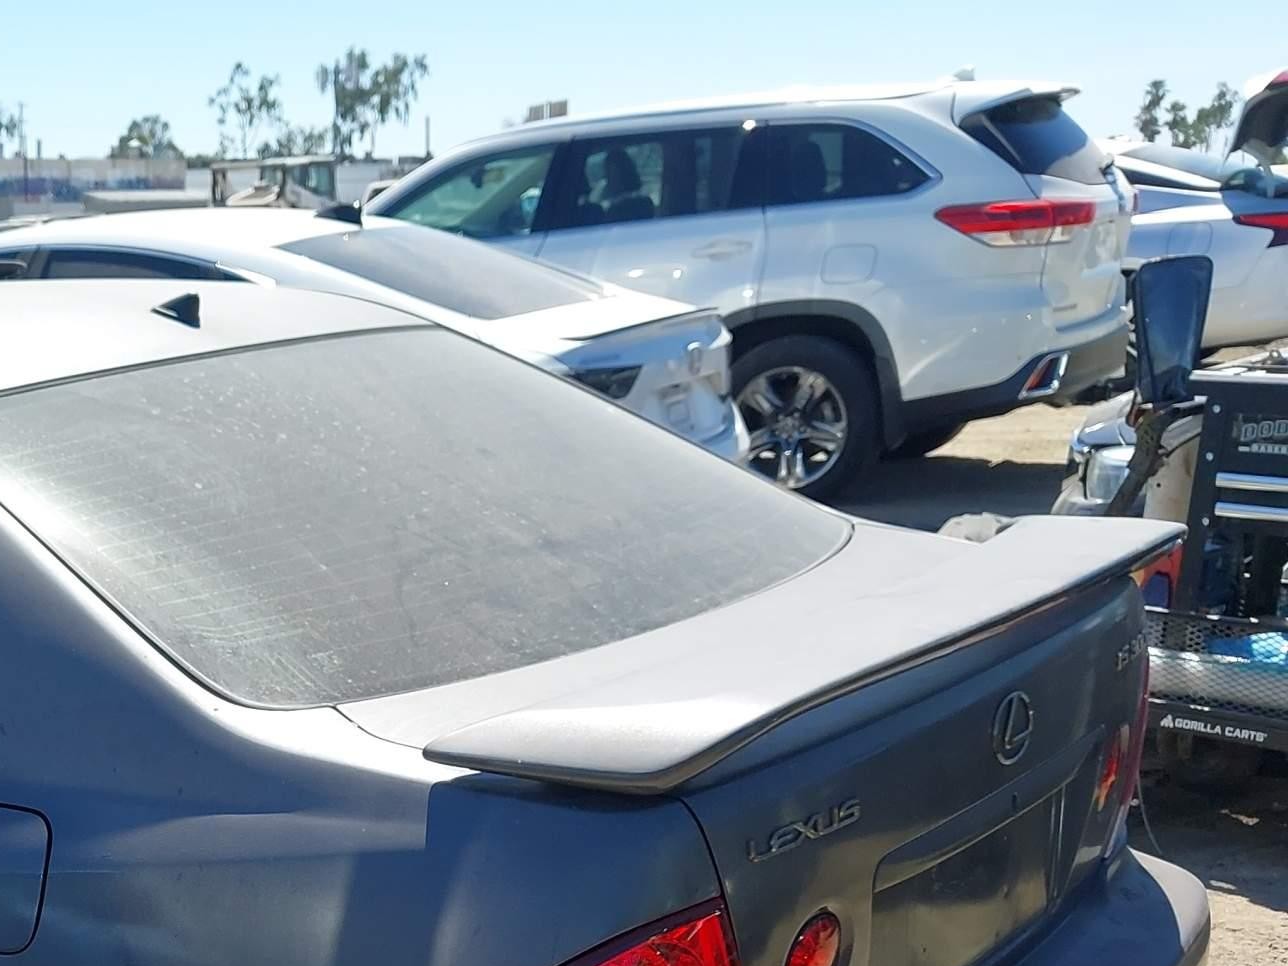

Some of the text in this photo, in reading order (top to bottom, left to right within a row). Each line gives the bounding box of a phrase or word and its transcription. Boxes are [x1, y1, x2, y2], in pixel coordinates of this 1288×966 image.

[1174, 717, 1265, 743] GORILLA CARTS
[747, 798, 861, 863] LEXUS
